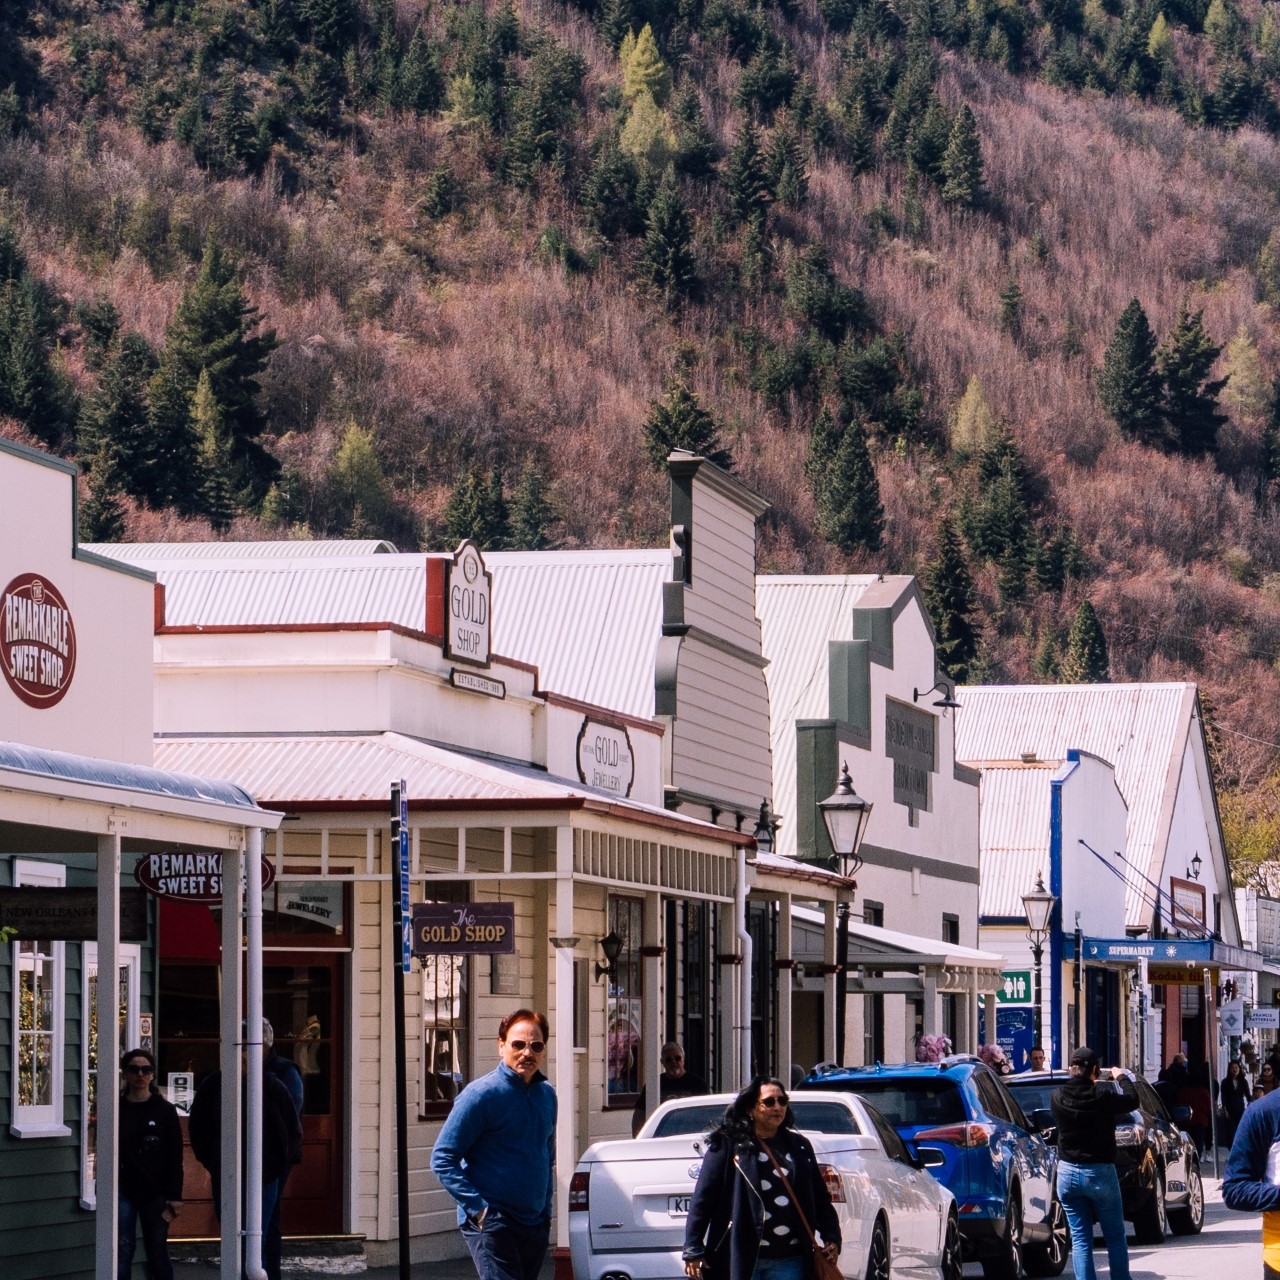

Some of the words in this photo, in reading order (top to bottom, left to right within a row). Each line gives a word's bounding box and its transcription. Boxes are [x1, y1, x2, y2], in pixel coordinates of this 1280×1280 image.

[32, 584, 43, 599] THE
[451, 585, 486, 626] GOLD
[6, 593, 68, 658] REMARKABLE
[457, 627, 481, 655] SHOP
[10, 645, 38, 683] SWEET
[40, 648, 64, 689] SHOP
[458, 674, 489, 691] ESTABLISHED
[595, 735, 618, 767] GOLD
[592, 768, 622, 791] JEWELLERY
[150, 854, 247, 878] REMARK
[158, 877, 205, 894] SWEET
[6, 907, 32, 917] NEW
[35, 906, 88, 918] ORLEANS
[287, 900, 333, 919] JEWELLERY
[453, 907, 477, 926] The
[421, 926, 461, 943] GOLD
[465, 925, 506, 943] SHOP
[1109, 946, 1155, 956] SUPERMARKET
[1149, 970, 1184, 980] Kodak
[1189, 971, 1204, 981] fil
